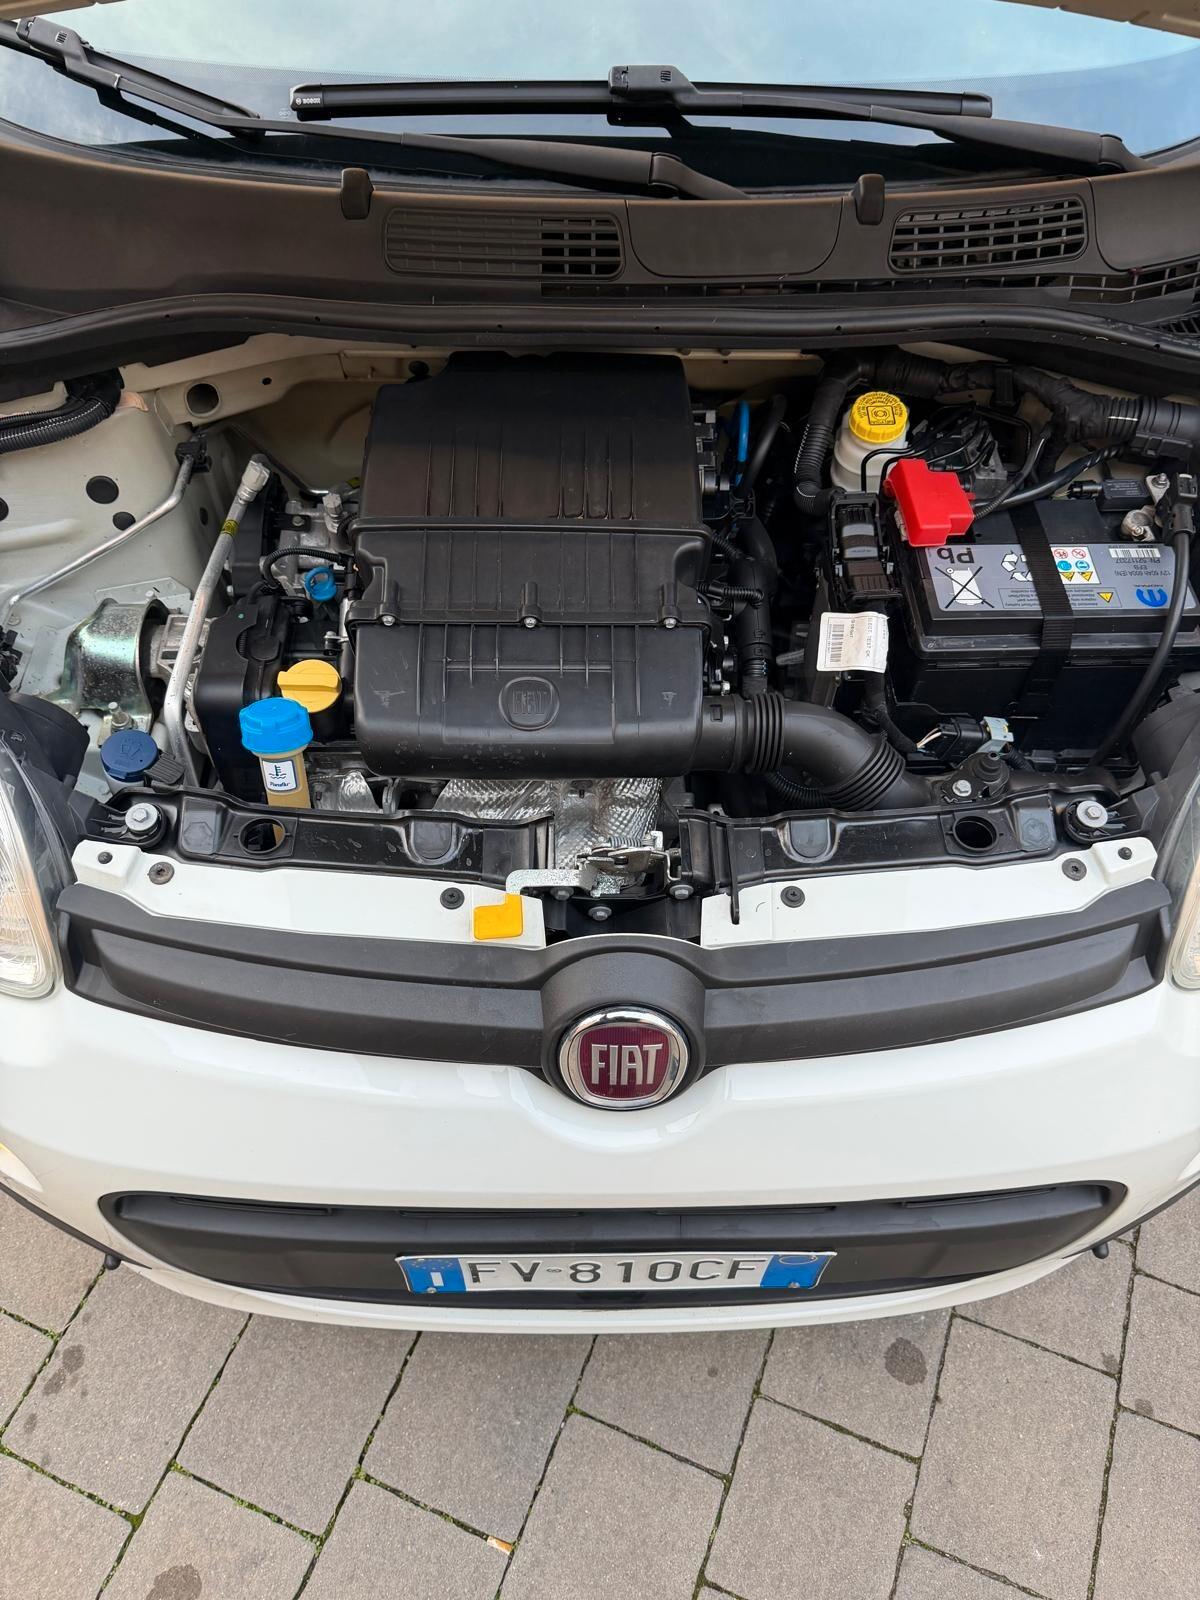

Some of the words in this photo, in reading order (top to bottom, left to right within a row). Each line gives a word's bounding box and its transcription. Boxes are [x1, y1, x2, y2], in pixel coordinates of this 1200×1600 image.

[936, 547, 974, 564] Pb
[591, 1043, 663, 1086] FIAT
[467, 1261, 541, 1283] FV
[569, 1258, 767, 1283] 810CF
